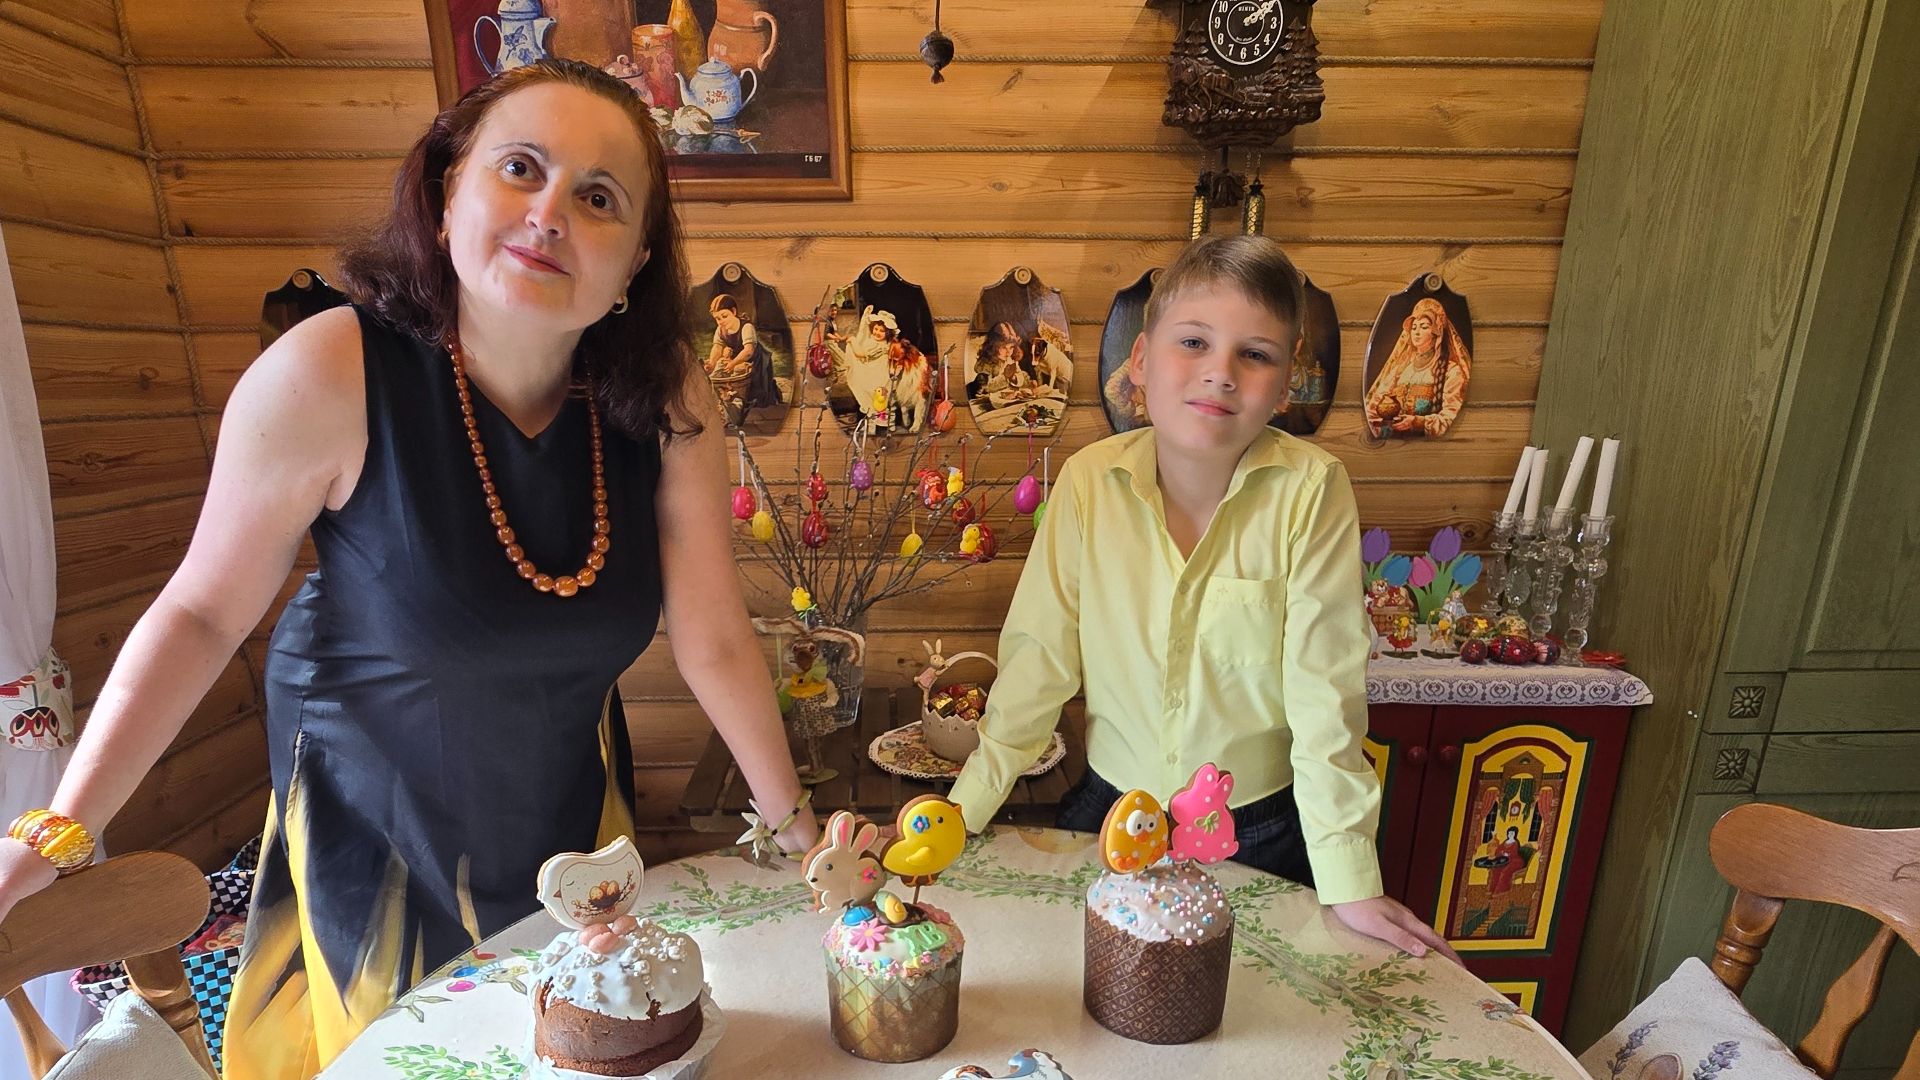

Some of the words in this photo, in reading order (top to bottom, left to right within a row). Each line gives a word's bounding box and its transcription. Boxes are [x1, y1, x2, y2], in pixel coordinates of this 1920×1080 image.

[1218, 0, 1229, 13] 10
[1214, 16, 1221, 29] 9
[1270, 17, 1278, 29] 3
[1217, 33, 1224, 45] 8
[1263, 33, 1271, 46] 4
[1228, 44, 1235, 56] 7
[1240, 47, 1247, 60] 6
[1253, 43, 1260, 56] 5
